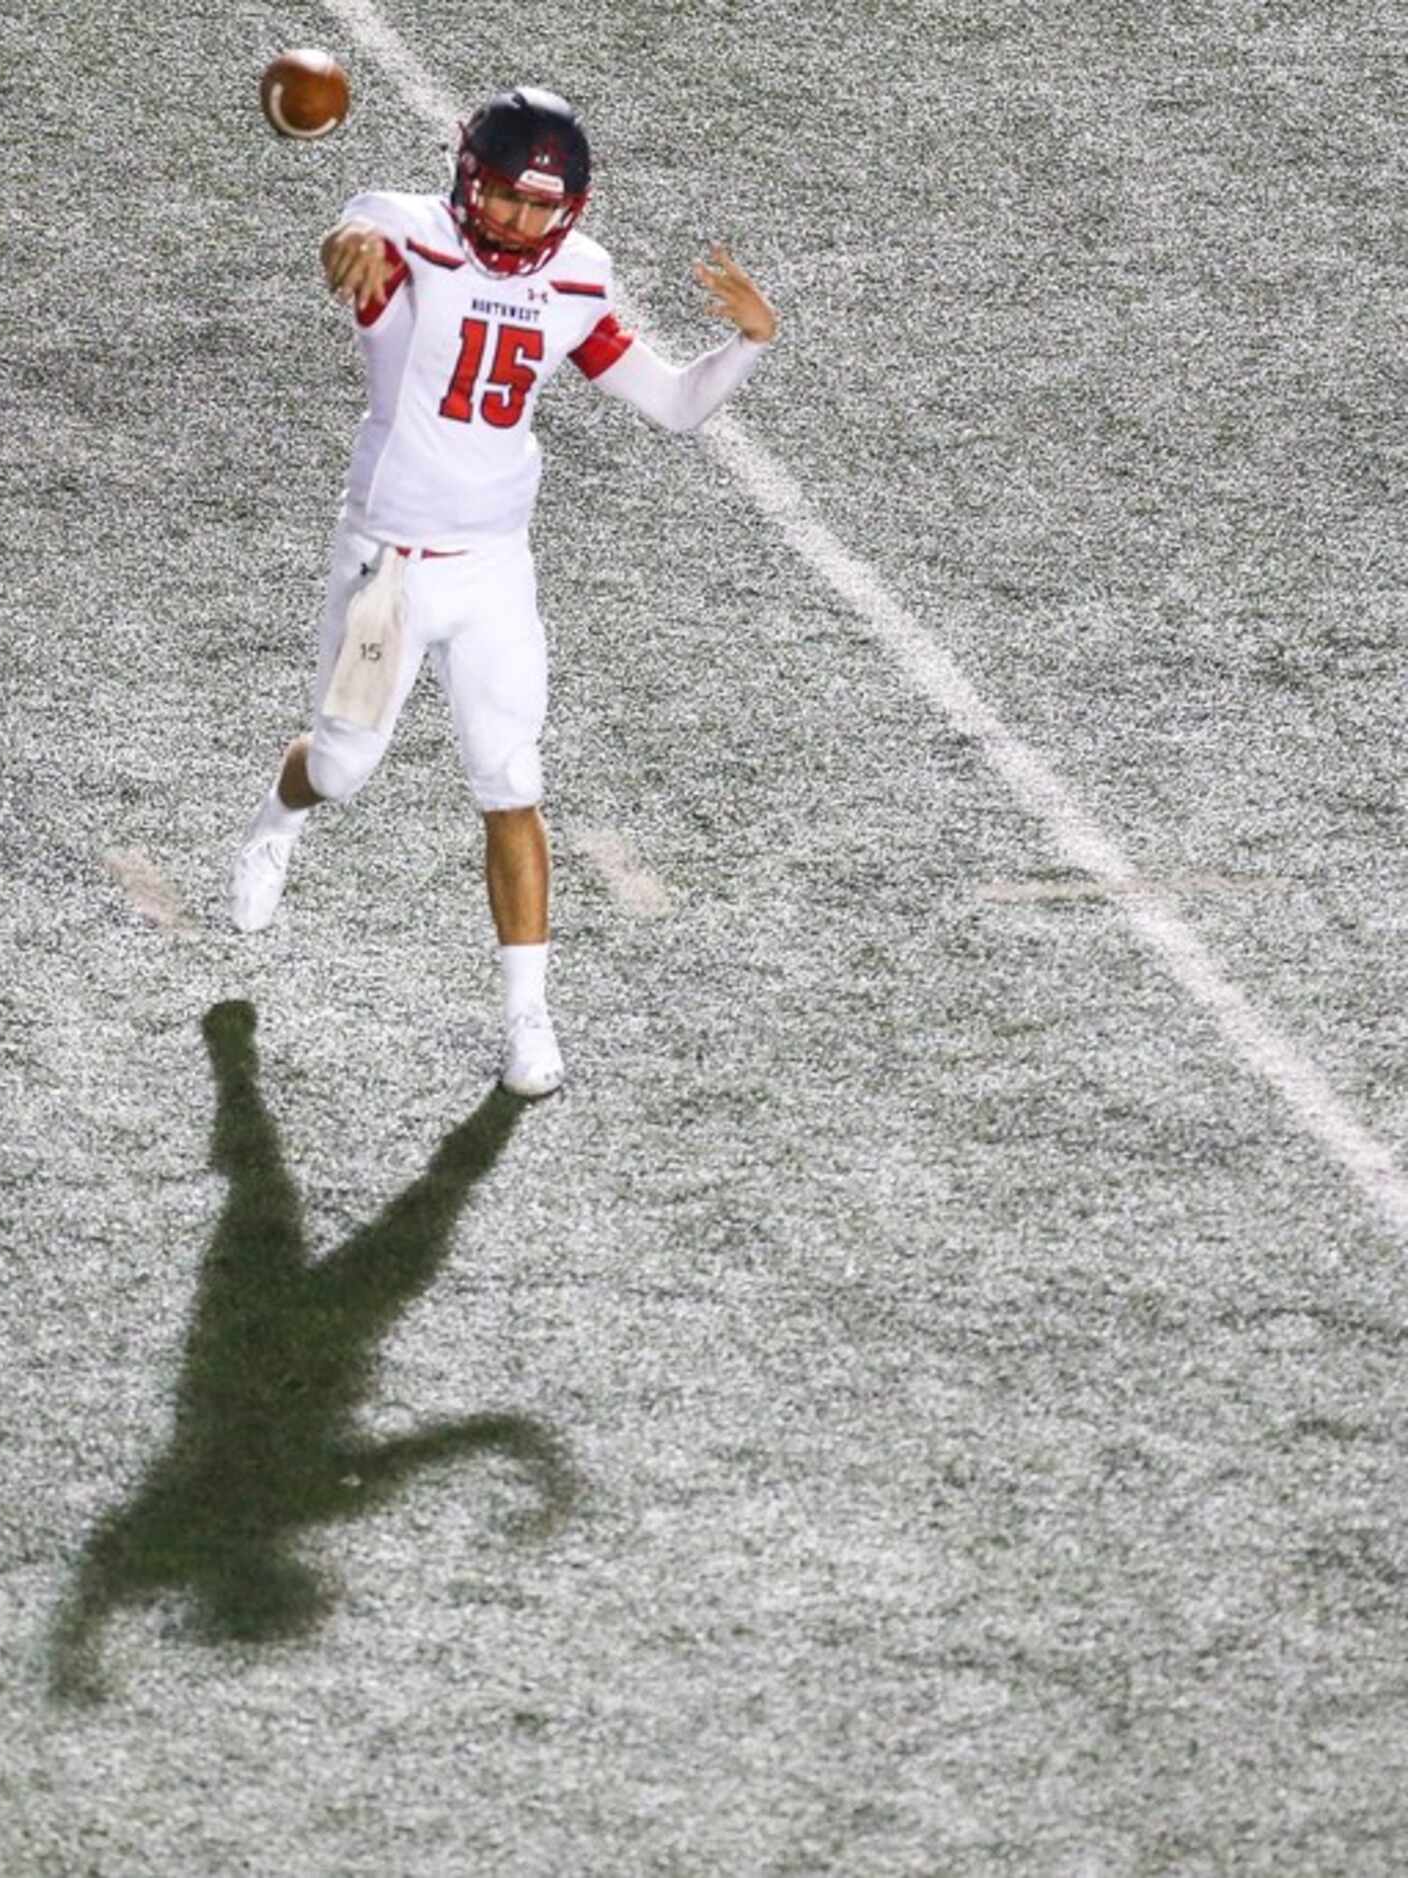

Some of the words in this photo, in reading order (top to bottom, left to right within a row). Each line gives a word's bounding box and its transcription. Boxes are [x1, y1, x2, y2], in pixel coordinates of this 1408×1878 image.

[471, 298, 541, 321] NORTHWEST
[438, 316, 544, 429] 15
[359, 642, 382, 663] 15
